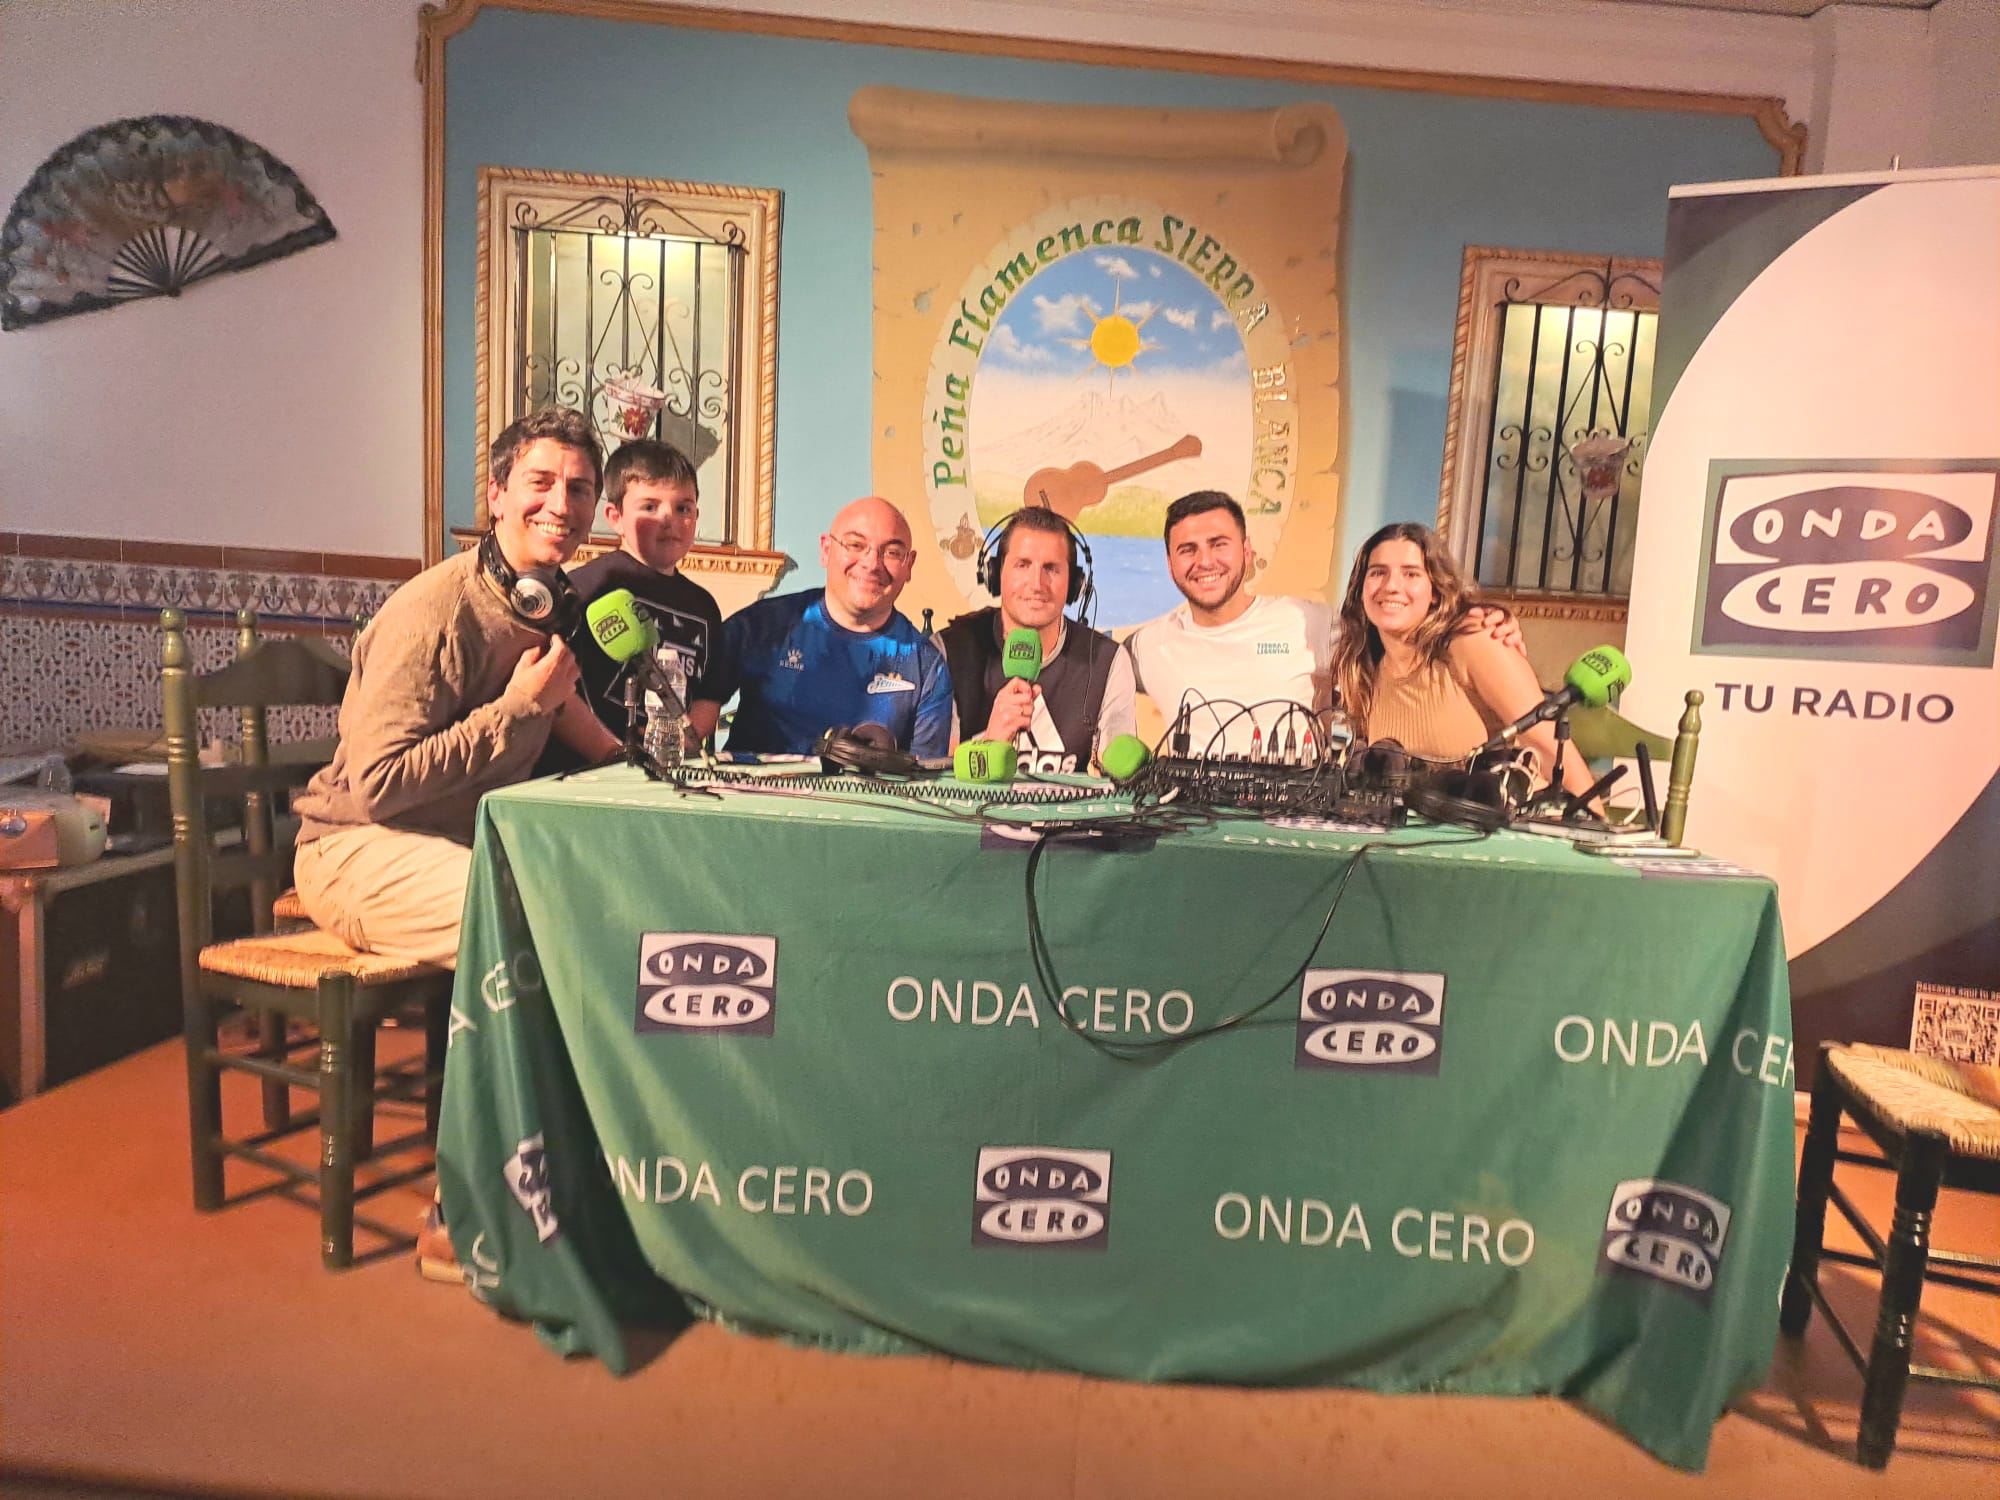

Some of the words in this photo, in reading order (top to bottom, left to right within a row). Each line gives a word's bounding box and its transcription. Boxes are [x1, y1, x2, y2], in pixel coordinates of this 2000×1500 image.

[948, 216, 1143, 358] Flamenca
[1154, 214, 1269, 335] SIERRA
[932, 373, 970, 489] Peña
[1247, 362, 1290, 515] BLANCA
[1752, 507, 1945, 544] ONDA
[1755, 576, 1940, 615] CERO
[1714, 682, 1774, 713] TU
[1791, 687, 1955, 724] RADIO
[658, 951, 755, 976] ONDA
[662, 992, 754, 1017] CERO
[887, 976, 1039, 1029] ONDA
[1058, 985, 1194, 1035] CERO
[1320, 988, 1420, 1014] ONDA
[1322, 1029, 1419, 1055] CERO
[1554, 1015, 1709, 1067] ONDA
[604, 1151, 721, 1206] NDA
[737, 1165, 872, 1216] CERO
[995, 1166, 1089, 1191] ONDA
[998, 1207, 1088, 1232] CERO
[1214, 1192, 1371, 1251] ONDA
[1391, 1207, 1535, 1267] CERO
[1625, 1197, 1713, 1243] ONDA
[1624, 1238, 1706, 1284] CERO
